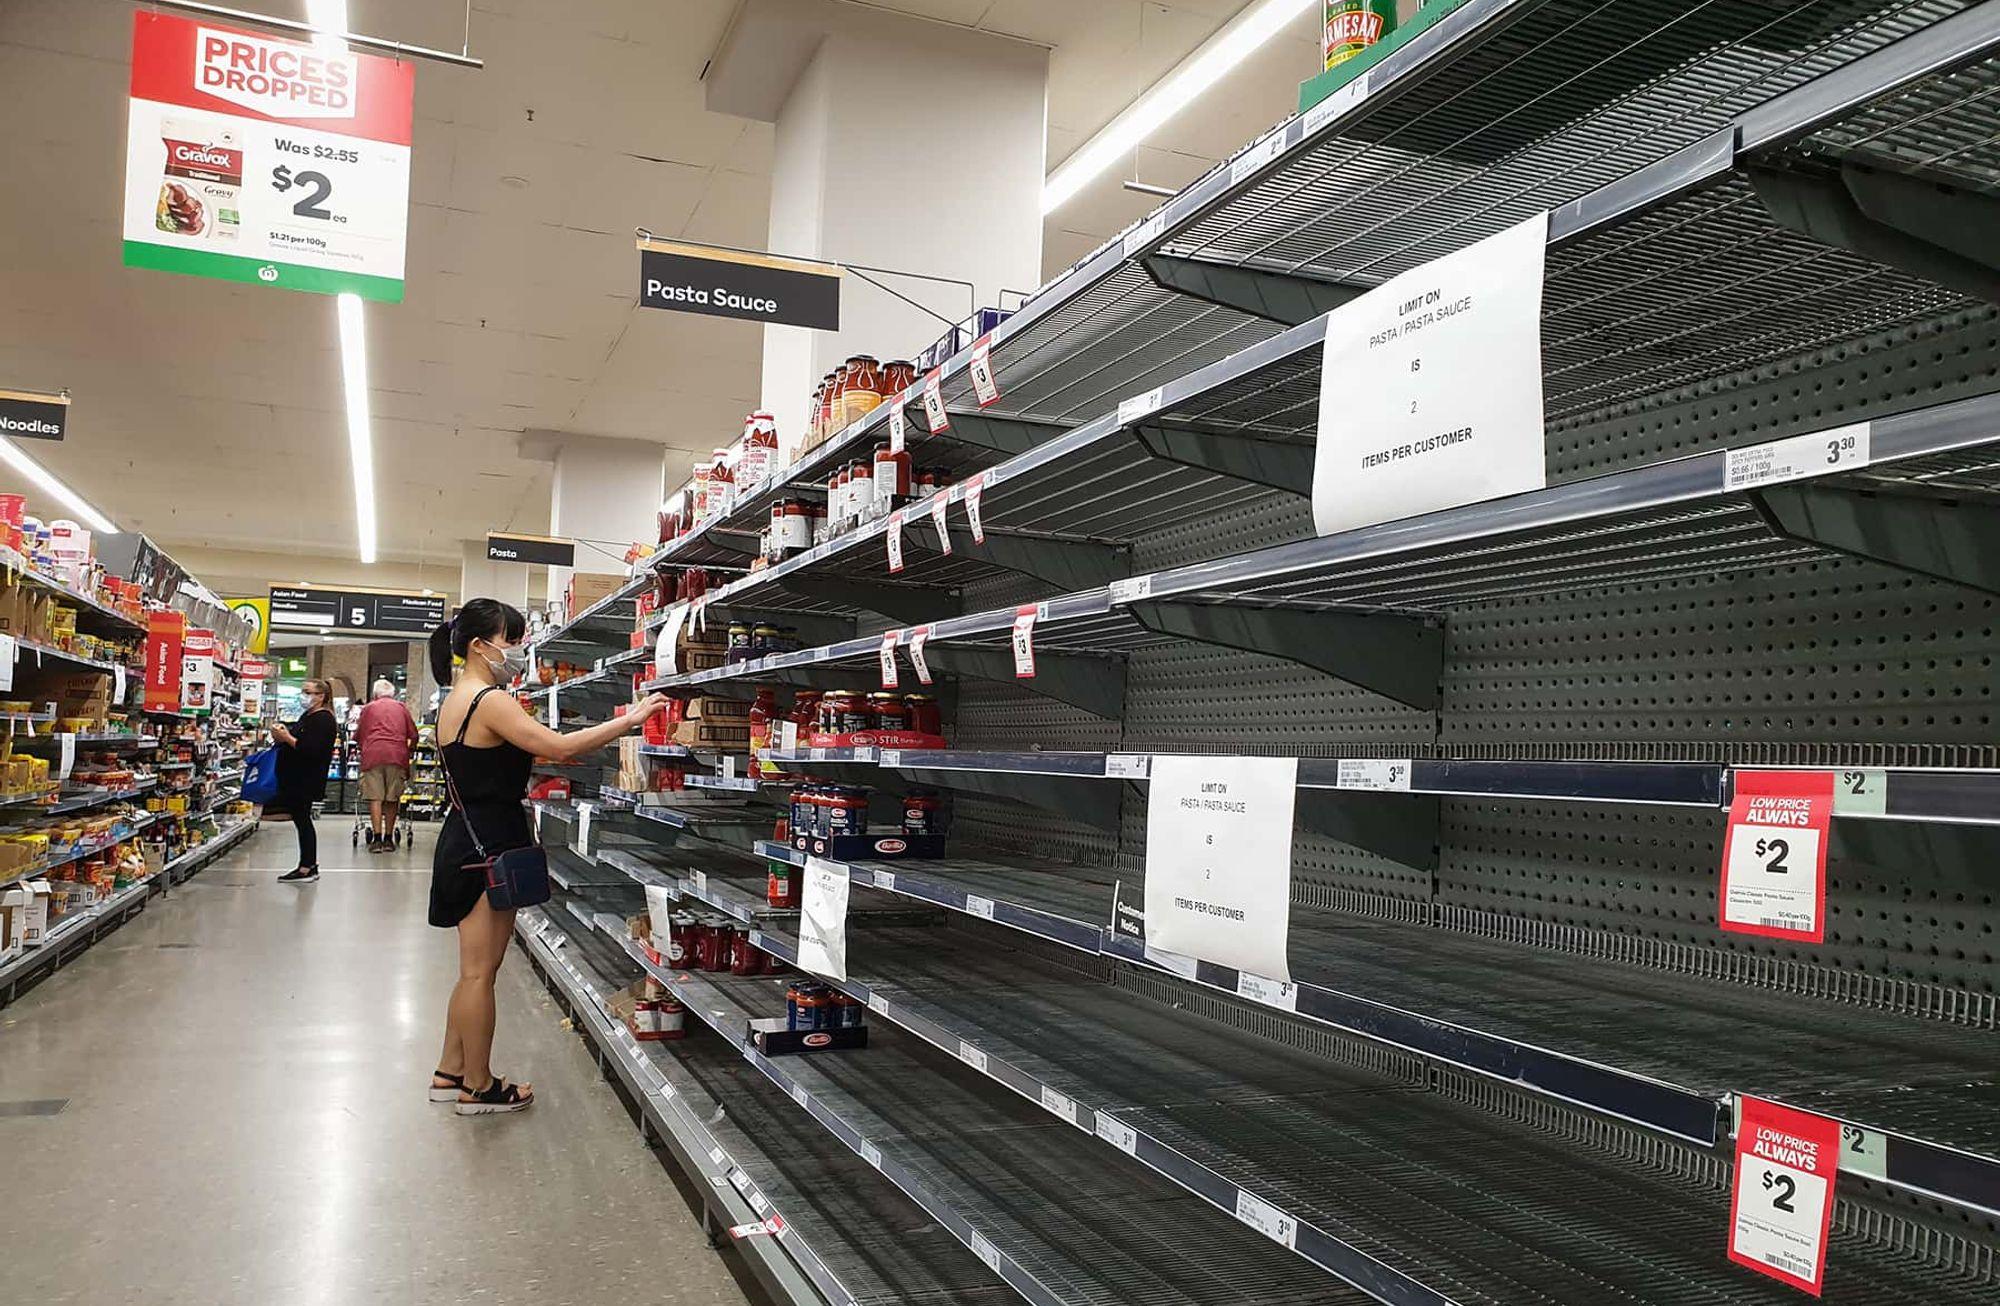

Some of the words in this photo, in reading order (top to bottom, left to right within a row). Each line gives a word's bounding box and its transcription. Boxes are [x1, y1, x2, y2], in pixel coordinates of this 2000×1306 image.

[204, 36, 349, 89] PRICES
[202, 65, 349, 110] DROPPED
[175, 145, 231, 168] Gravox
[275, 138, 310, 155] Was
[313, 145, 359, 164] $2.55
[272, 164, 332, 221] $2
[332, 214, 347, 224] ea
[290, 236, 305, 245] per
[306, 237, 327, 248] 100g
[647, 278, 708, 305] Pasta
[712, 288, 777, 313] Sauce
[1399, 295, 1424, 316] LIMIT
[1425, 288, 1441, 304] ON
[1369, 328, 1398, 349] PASTA
[1404, 312, 1434, 334] PASTA
[1436, 296, 1471, 321] SAUCE
[1411, 358, 1421, 372] IS
[1410, 400, 1418, 414] 2
[0, 417, 60, 435] Noodles
[1361, 450, 1390, 469] ITEMS
[1392, 444, 1412, 461] PER
[1414, 427, 1472, 454] CUSTOMER
[489, 547, 517, 559] Pasta
[350, 607, 367, 626] 5
[160, 642, 169, 667] Asian
[157, 667, 167, 685] Food
[879, 735, 900, 745] STIR
[1201, 782, 1218, 793] LIMIT
[1218, 783, 1227, 794] ON
[1843, 771, 1866, 795] $2
[1180, 797, 1200, 809] PASTA
[1204, 799, 1223, 811] PASTA
[1224, 801, 1246, 813] SAUCE
[1750, 798, 1779, 809] LOW
[1778, 798, 1812, 810] PRICE
[1746, 809, 1810, 826] ALWAYS
[1205, 834, 1213, 845] IS
[1755, 838, 1790, 874] $2
[1206, 868, 1211, 880] 2
[1174, 897, 1193, 910] ITEMS
[1194, 901, 1208, 914] PER
[1208, 904, 1245, 922] CUSTOMER
[1120, 918, 1140, 936] Notice
[1756, 1127, 1783, 1145] LOW
[1783, 1135, 1818, 1156] PRICE
[1842, 1126, 1865, 1154] $2
[1753, 1140, 1816, 1171] ALWAYS
[1762, 1170, 1796, 1214] $2
